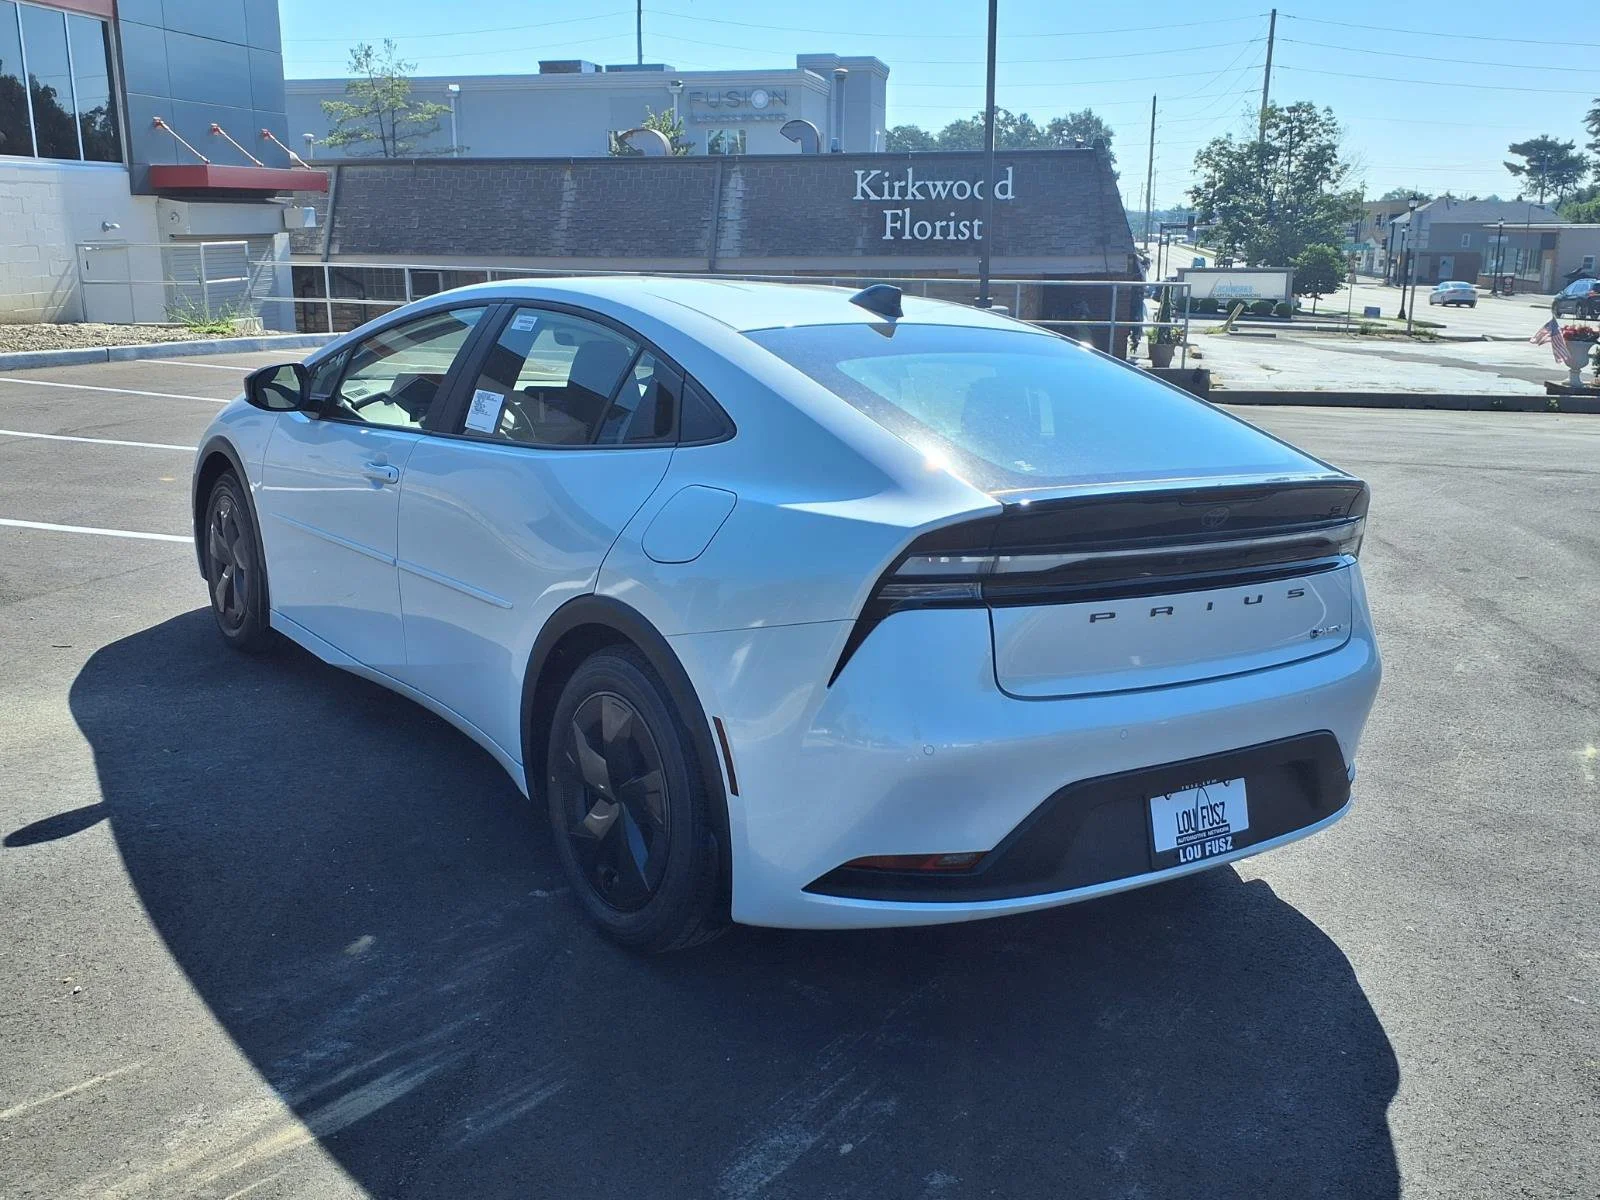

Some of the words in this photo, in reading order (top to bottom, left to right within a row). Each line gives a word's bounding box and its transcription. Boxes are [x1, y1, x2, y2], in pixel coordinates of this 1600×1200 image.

[689, 89, 788, 109] FUSION
[852, 166, 1015, 200] Kirkwood
[882, 207, 983, 240] Florist
[1089, 588, 1305, 623] PRIUS
[1176, 808, 1197, 834] LOU
[1200, 801, 1227, 829] FUSZ
[1178, 832, 1207, 844] AUTOMOTIVE
[1207, 826, 1230, 837] NETWORK
[1180, 846, 1202, 863] LOU
[1205, 836, 1233, 856] FUSZ
